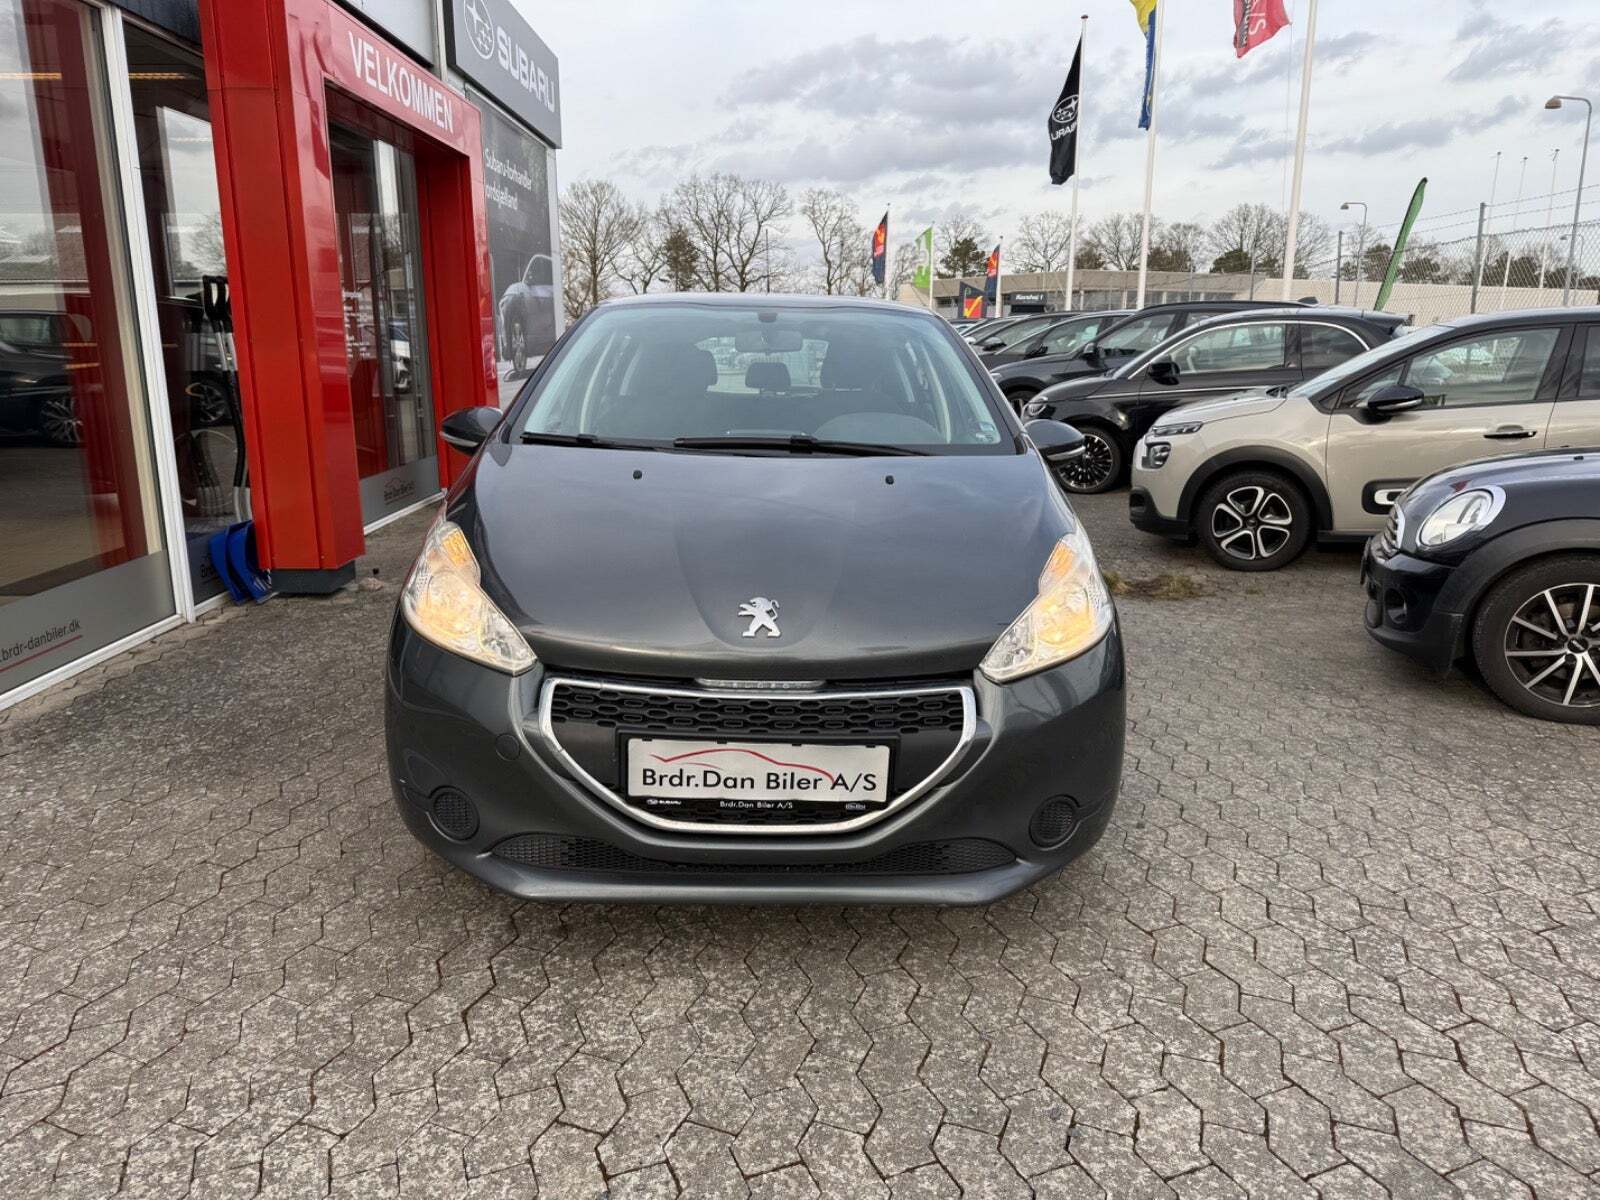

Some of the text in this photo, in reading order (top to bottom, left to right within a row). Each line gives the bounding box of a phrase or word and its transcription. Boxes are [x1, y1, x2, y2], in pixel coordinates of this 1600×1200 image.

[348, 31, 454, 133] VELKOMMEN
[497, 26, 555, 113] SUBARU
[642, 768, 877, 793] Brdr.Dan Biler A/S
[757, 801, 774, 809] Biler
